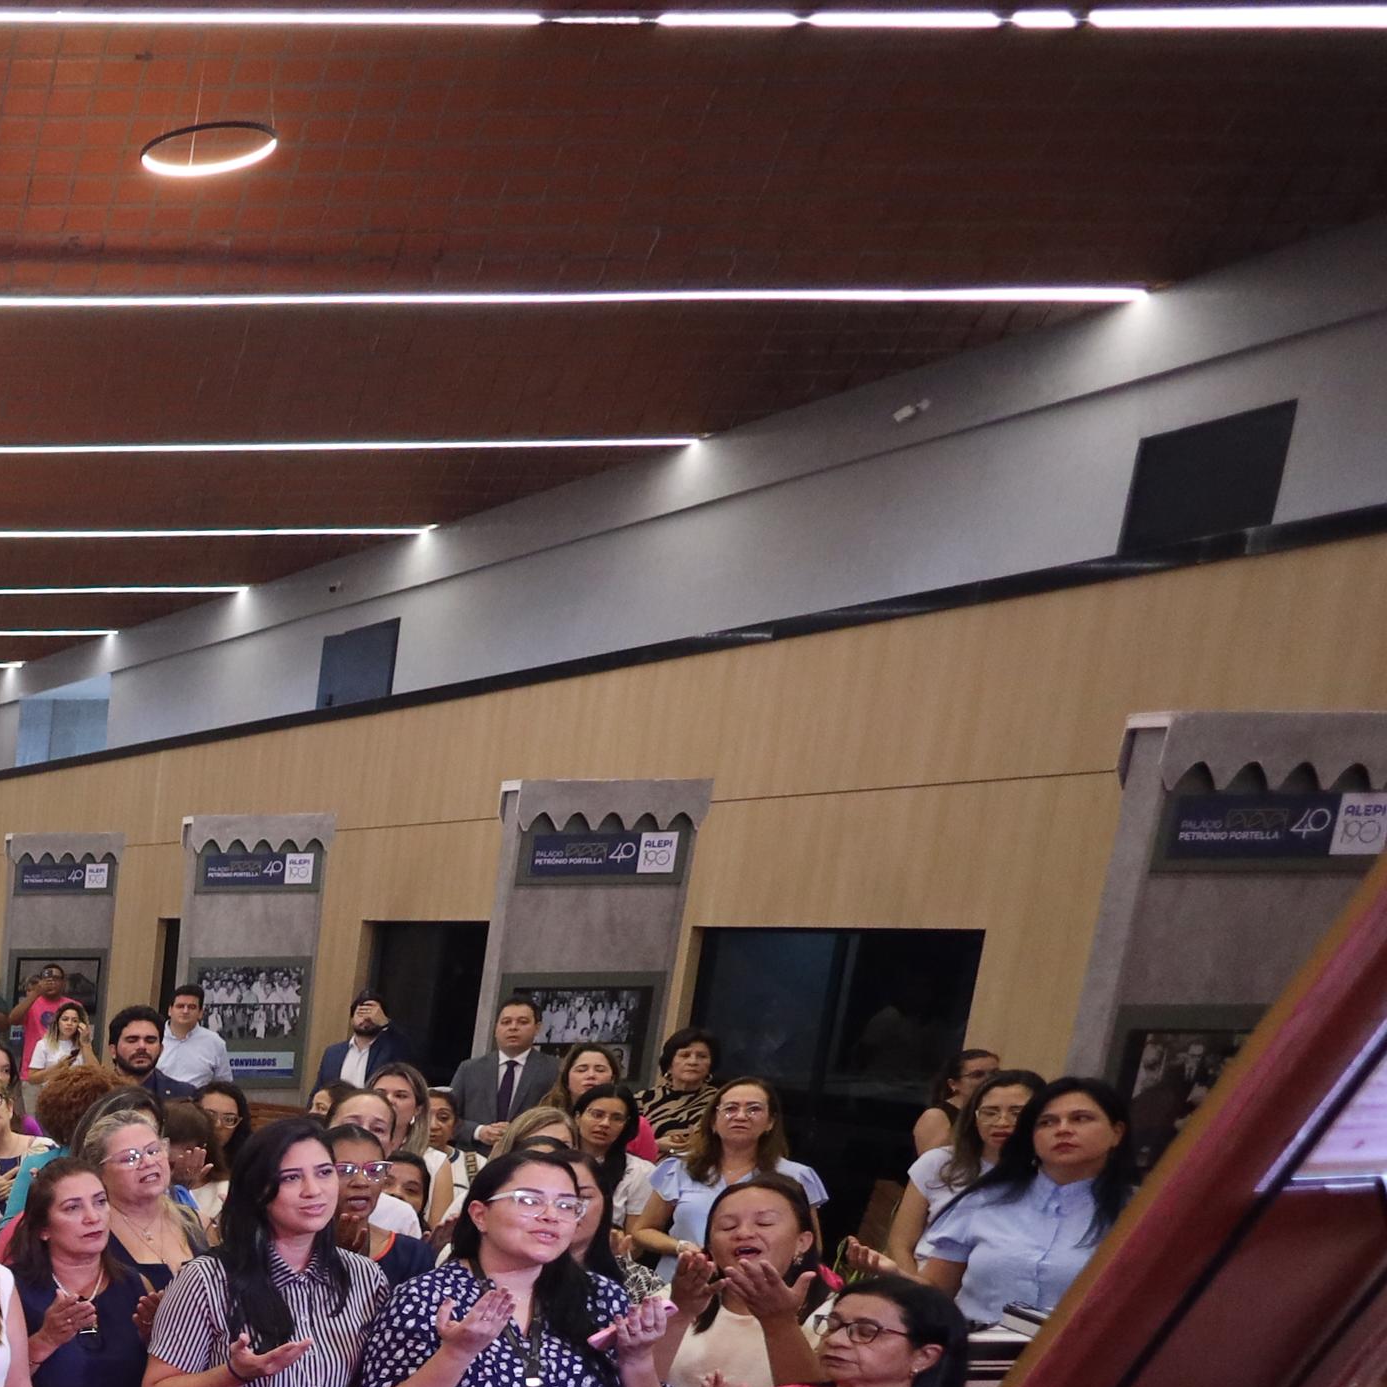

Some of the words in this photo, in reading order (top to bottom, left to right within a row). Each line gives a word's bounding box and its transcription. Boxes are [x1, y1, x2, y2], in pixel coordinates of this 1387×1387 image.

[1344, 804, 1387, 816] ALEPI
[1290, 808, 1332, 839] 40
[1178, 829, 1228, 841] PETRÔNIO
[1229, 831, 1280, 840] PORTELLA
[644, 839, 673, 848] ALEPI
[608, 842, 636, 863] 40
[263, 860, 283, 877] 40
[229, 1058, 277, 1067] CONVIDADOS
